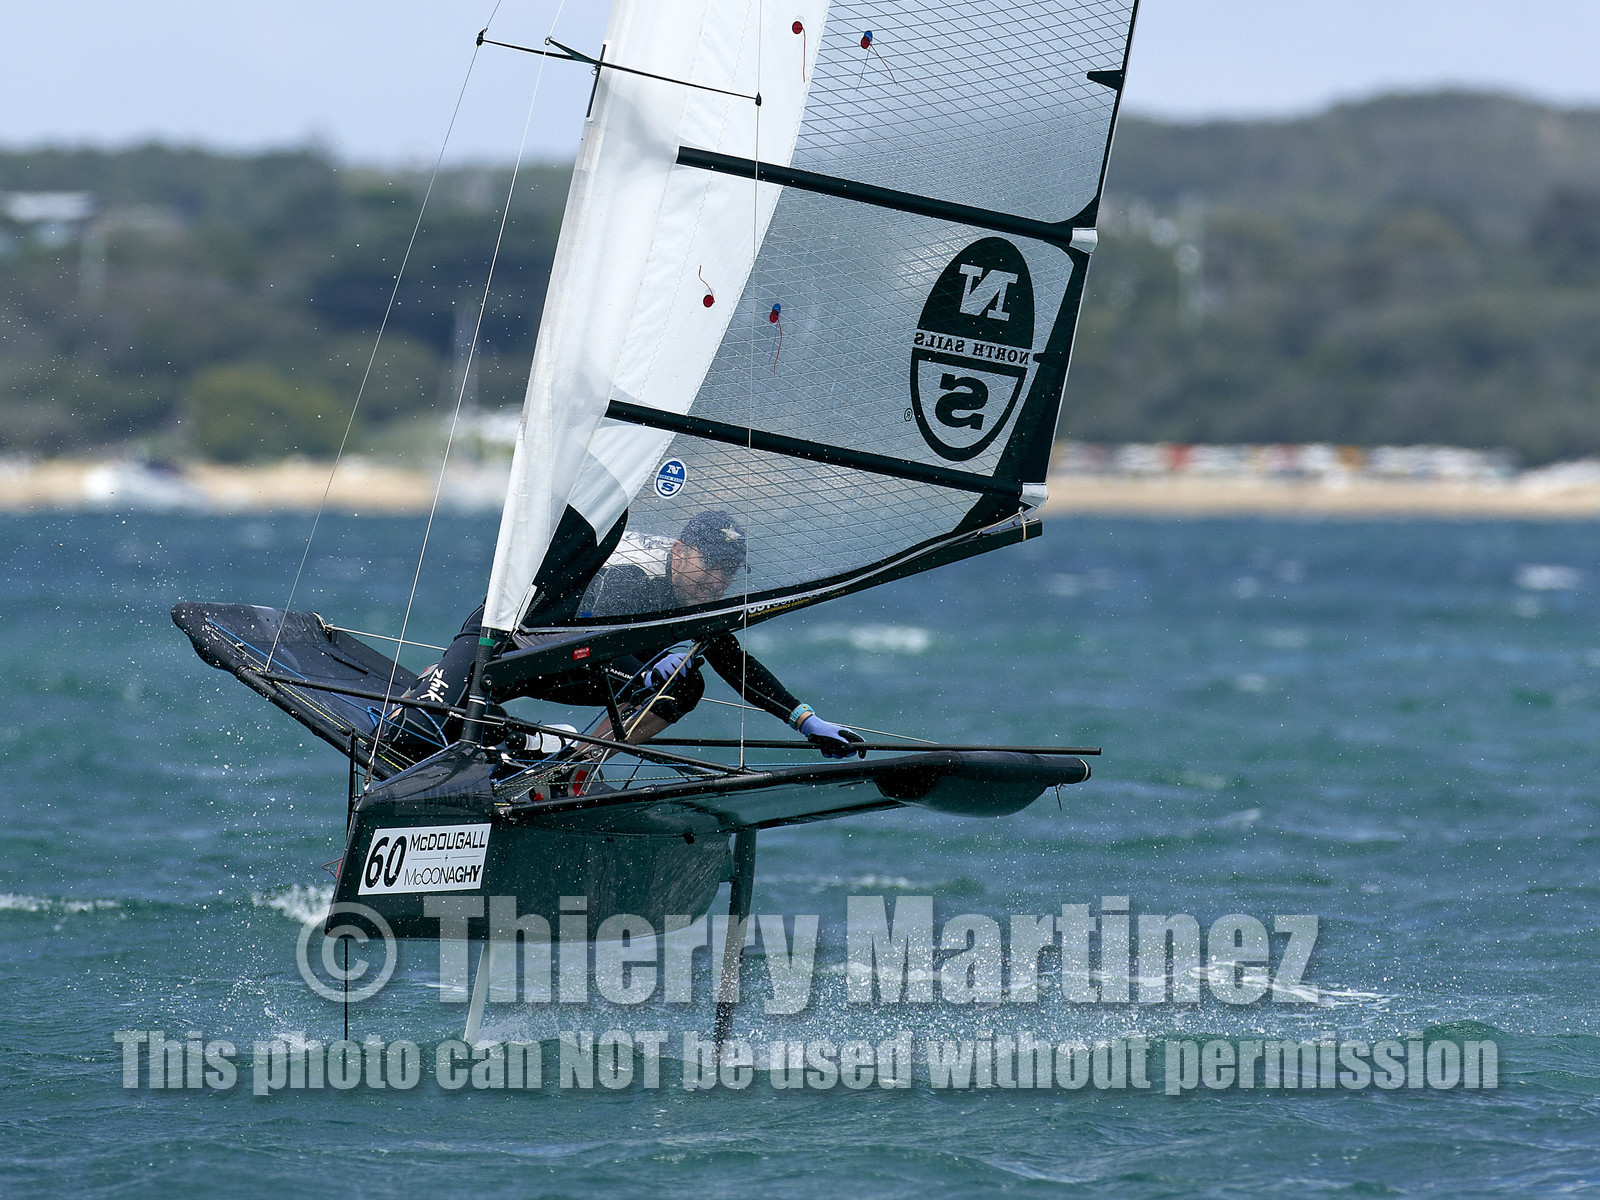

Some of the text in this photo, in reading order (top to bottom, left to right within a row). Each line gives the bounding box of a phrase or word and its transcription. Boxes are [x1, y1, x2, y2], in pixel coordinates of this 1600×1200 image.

[666, 464, 682, 475] N
[661, 482, 675, 492] S
[420, 669, 449, 703] zhik
[365, 831, 486, 889] 60 McDOUGALL
[404, 865, 482, 885] McCONAGHY
